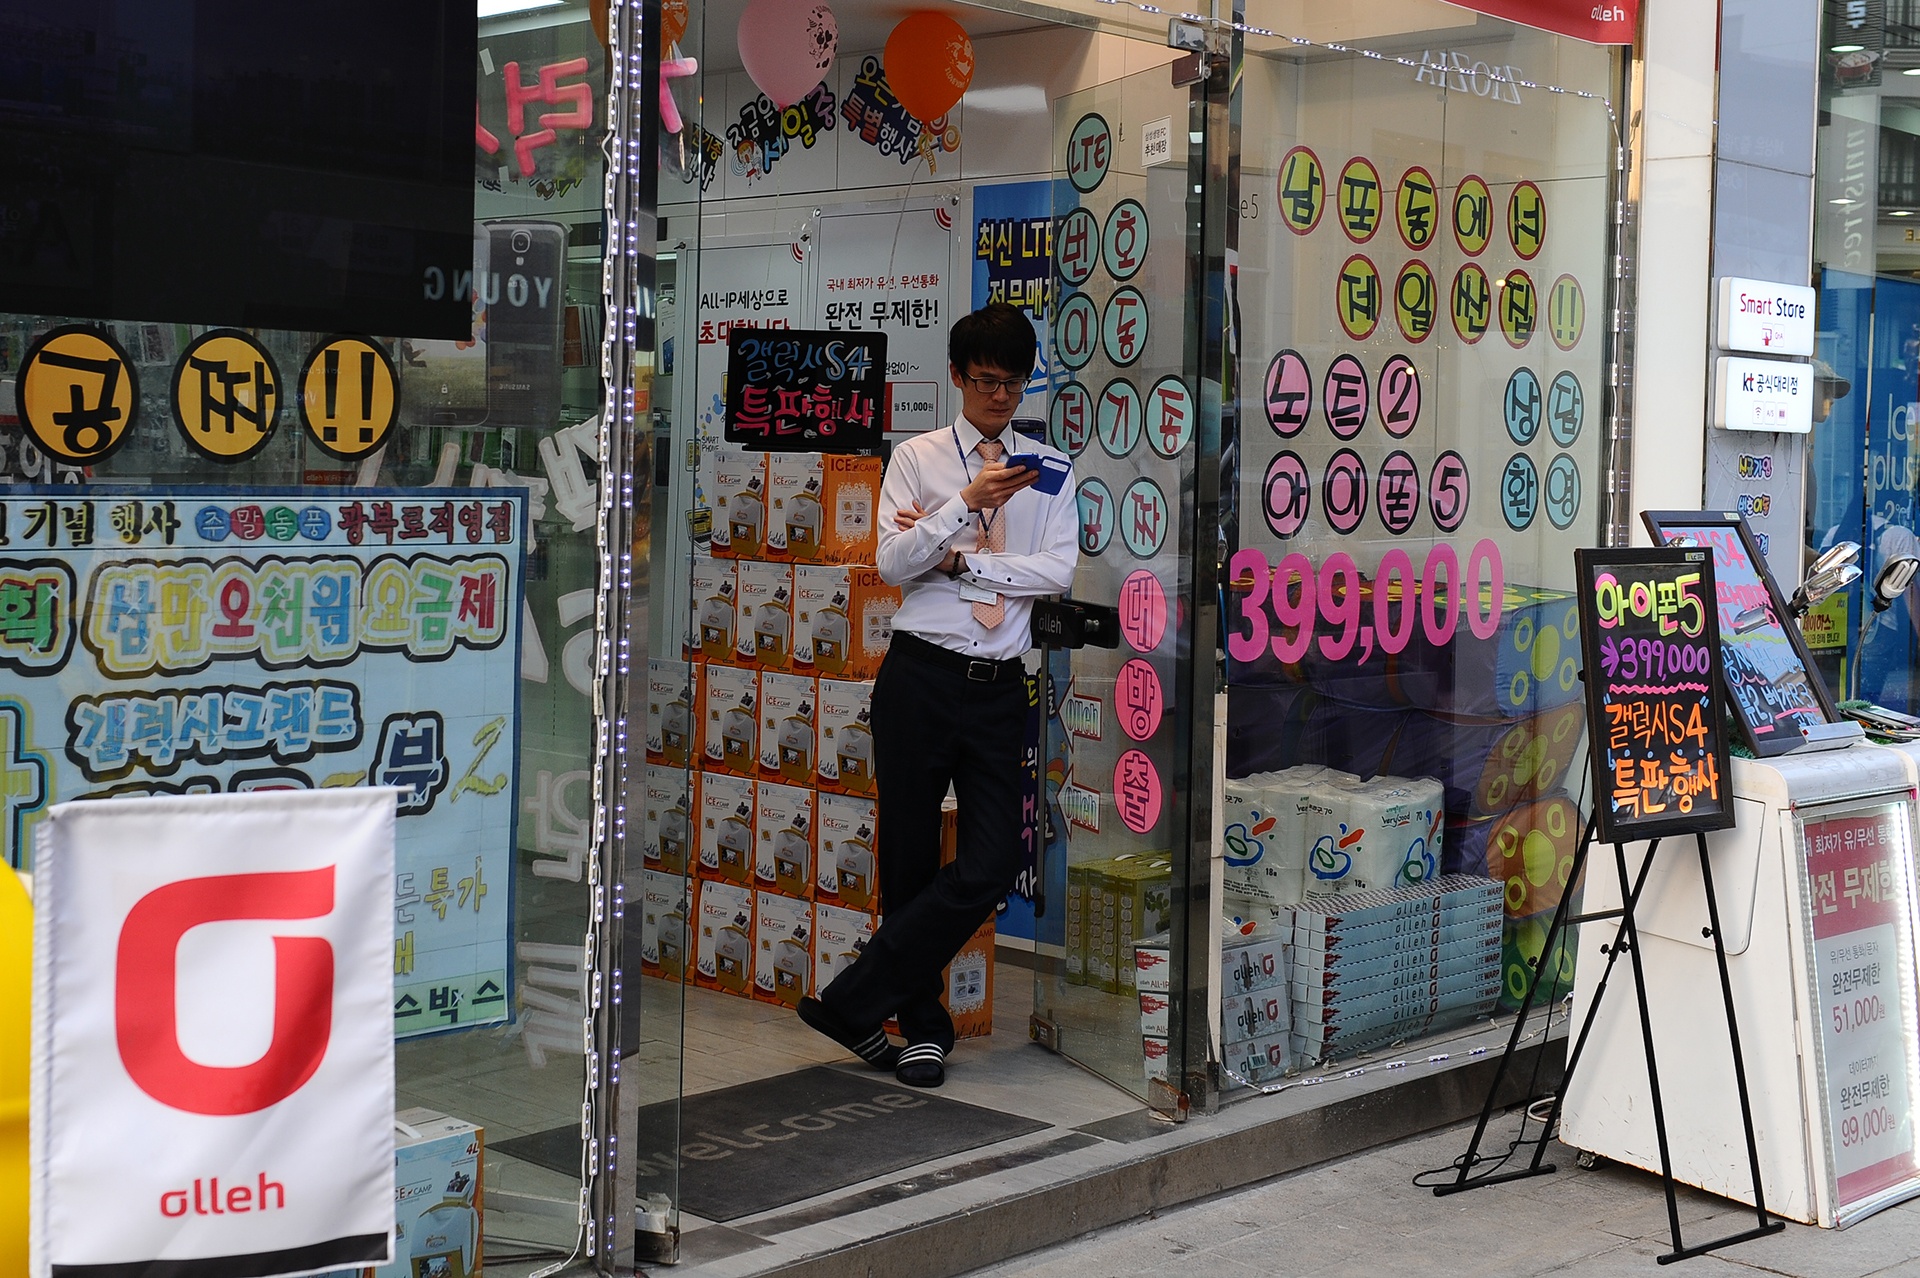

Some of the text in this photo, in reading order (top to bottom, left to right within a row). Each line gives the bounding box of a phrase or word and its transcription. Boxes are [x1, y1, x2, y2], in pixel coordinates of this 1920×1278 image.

[1591, 5, 1625, 22] olleh
[1071, 132, 1107, 175] LTE
[978, 222, 1013, 266] 최신
[1063, 209, 1139, 279] 번호
[827, 278, 844, 293] 국내
[847, 277, 874, 291] 최저가
[900, 273, 939, 289] 무선통화
[825, 301, 863, 331] 완전
[1065, 296, 1139, 360] 이동
[1740, 293, 1805, 319] Smart Store
[738, 338, 873, 382] 갤럭시S4
[1743, 372, 1799, 396] kt 공식대리점
[733, 383, 875, 437] 특판행사
[1060, 387, 1185, 455] 전기종
[831, 458, 851, 472] ICE
[23, 501, 95, 547] 기념
[111, 501, 181, 546] 행사
[198, 506, 328, 541] 주말돌풍
[338, 500, 512, 546] 광복로직영점
[857, 573, 878, 587] ICE
[1228, 538, 1504, 665] 399,000
[370, 572, 498, 642] 요금제
[1039, 613, 1062, 636] olleh
[1595, 572, 1706, 639] 아이폰5
[1612, 751, 1720, 819] 특판행사
[1815, 825, 1875, 855] 최저가 유/무선
[466, 1141, 480, 1156] 4L
[636, 1093, 929, 1178] welcome
[160, 1171, 285, 1218] olleh
[413, 1184, 433, 1197] CAMP
